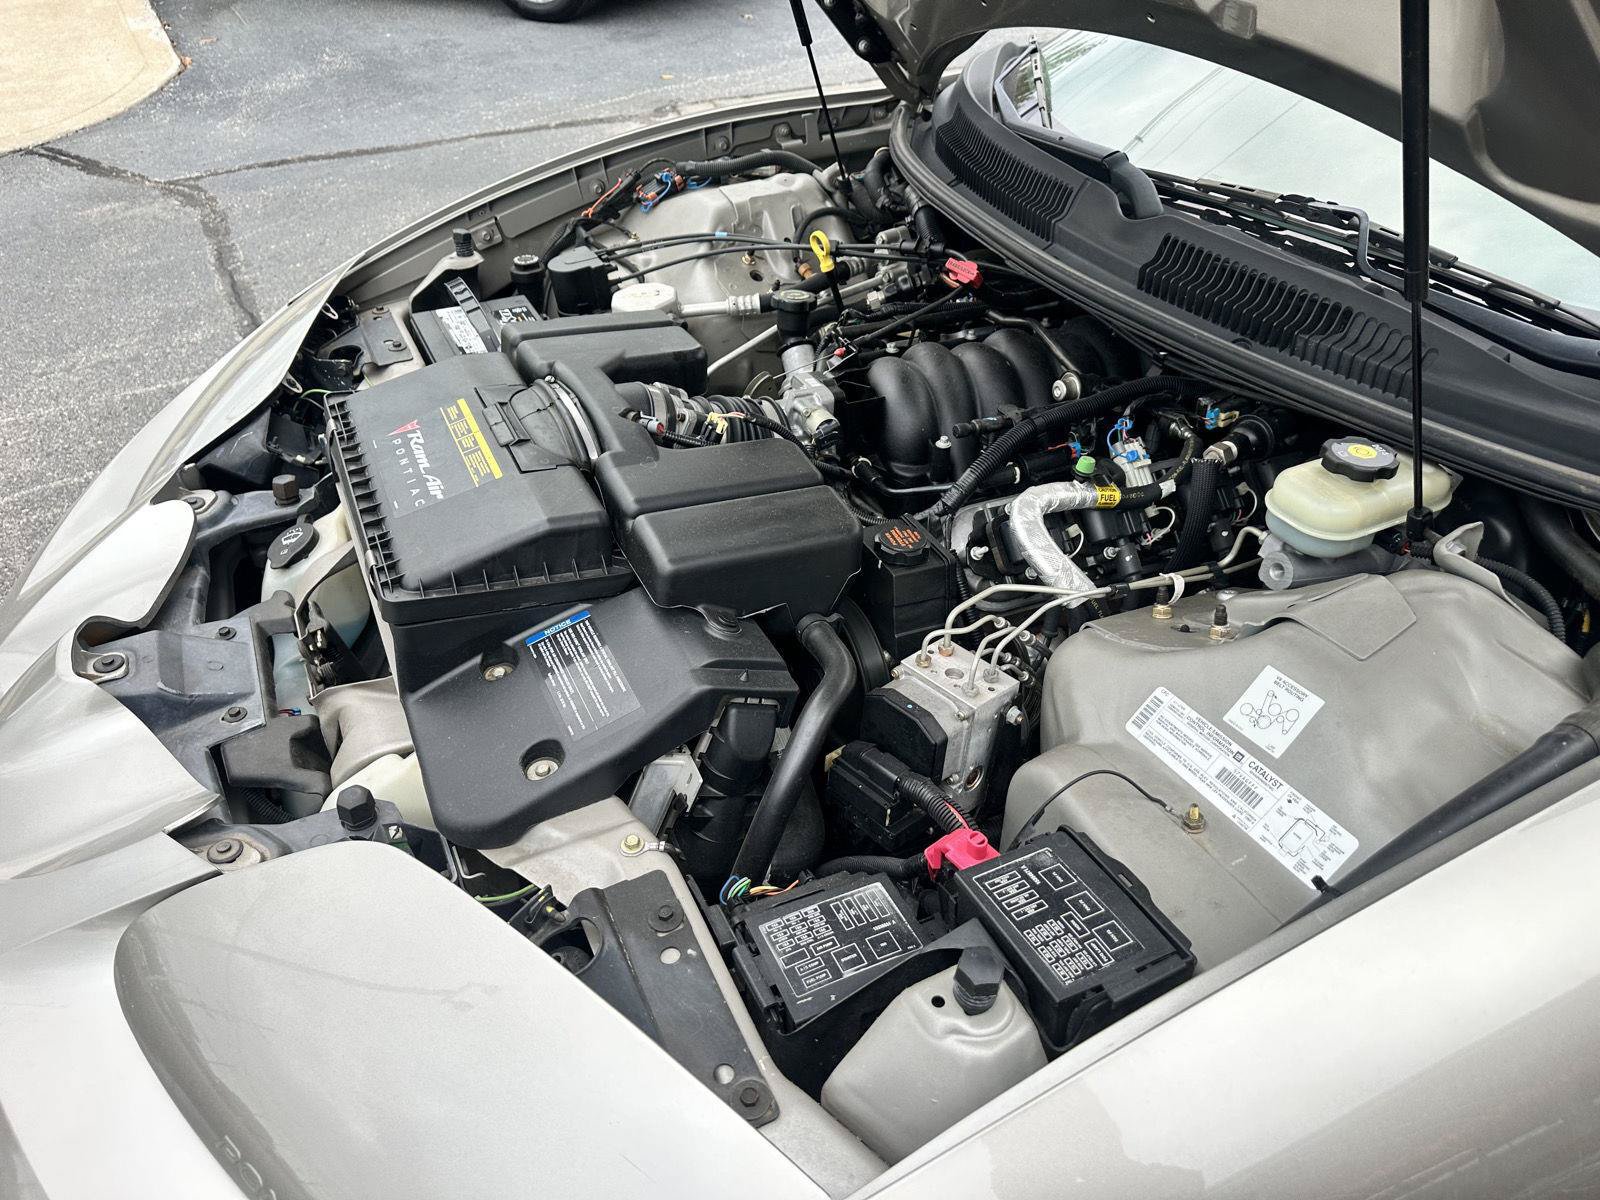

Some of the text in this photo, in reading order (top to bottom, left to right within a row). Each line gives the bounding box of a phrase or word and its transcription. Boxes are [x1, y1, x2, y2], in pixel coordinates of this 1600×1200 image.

[392, 437, 426, 508] PONTIAC
[406, 429, 444, 501] Ram Air
[1099, 492, 1116, 502] FUEL
[543, 618, 571, 635] NOTICE
[1273, 679, 1304, 702] BELT ROUTING
[1281, 679, 1308, 698] ACCESSORY
[1185, 715, 1236, 755] CONTROL INFORMATION
[1194, 716, 1233, 746] VEHICLE EMISSION
[1247, 760, 1284, 791] CATALYST
[216, 1135, 276, 1200] PO
